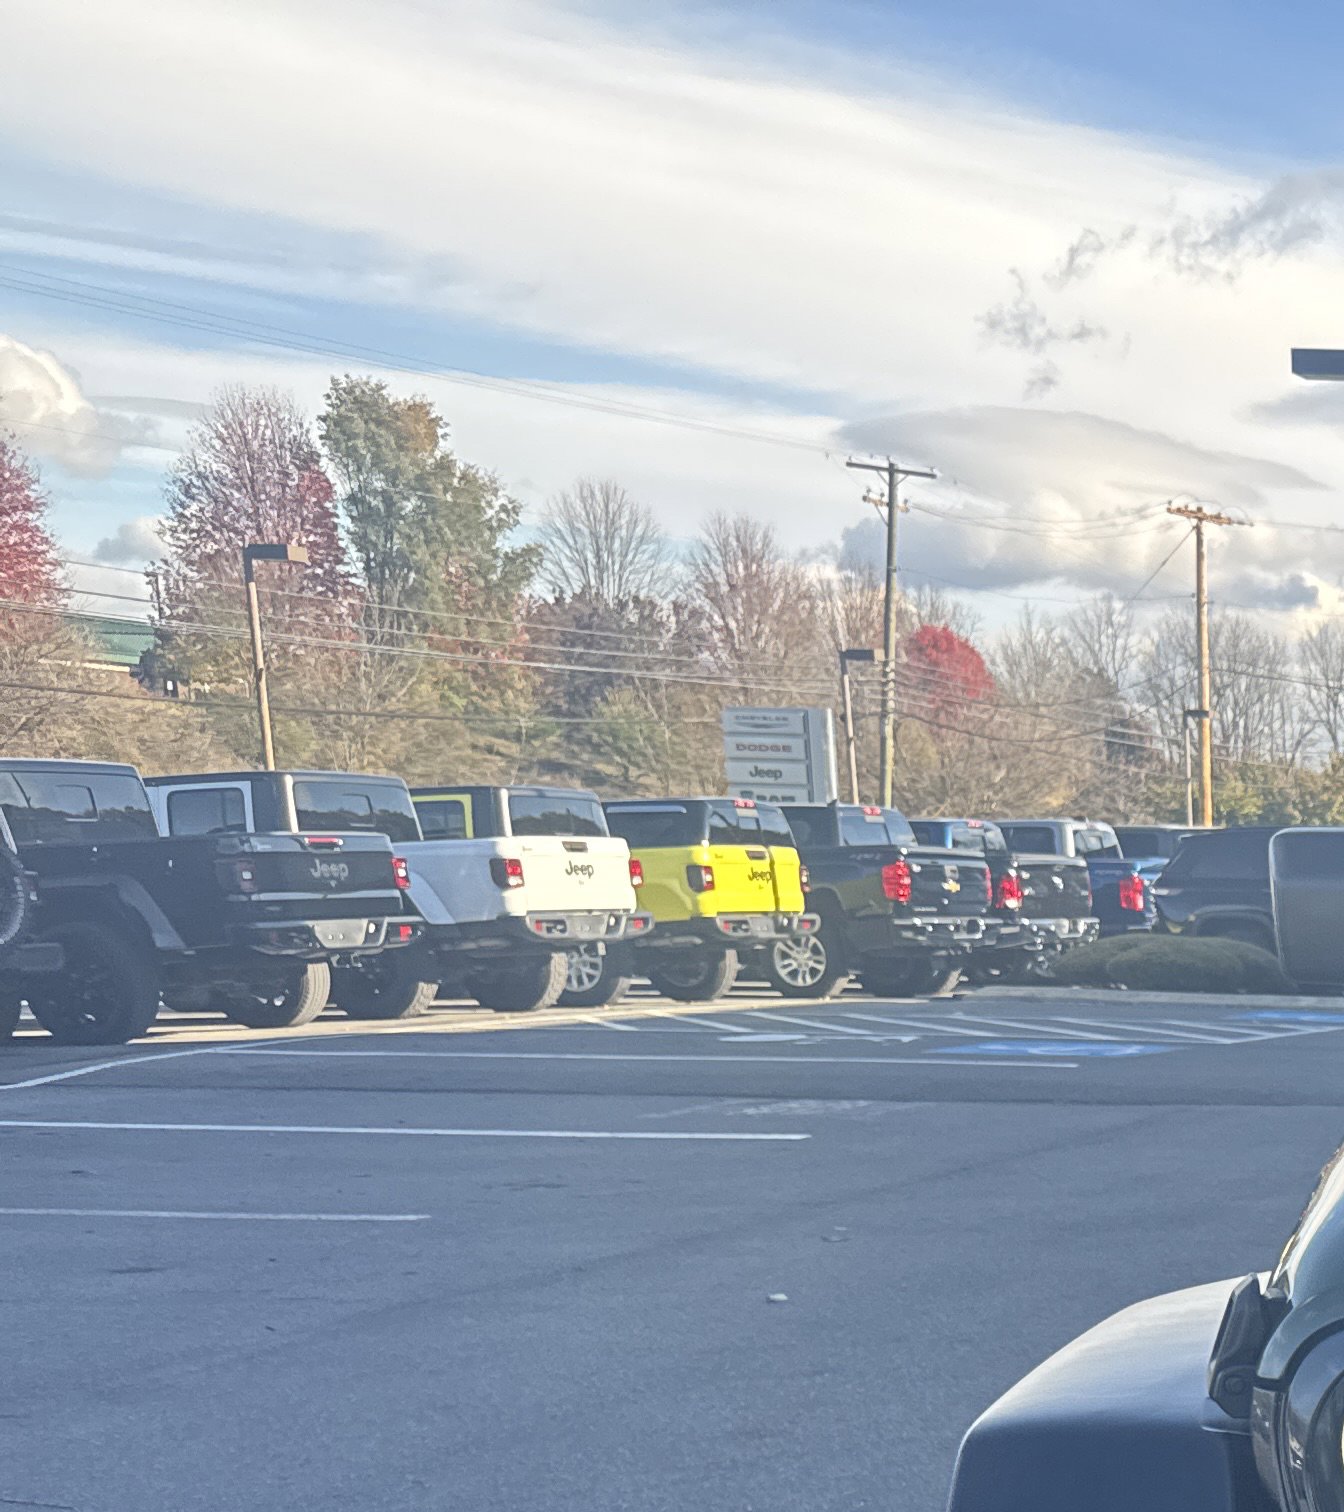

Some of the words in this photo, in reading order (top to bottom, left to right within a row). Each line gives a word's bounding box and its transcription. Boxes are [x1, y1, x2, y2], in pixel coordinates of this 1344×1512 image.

[735, 743, 793, 753] DODGE
[749, 765, 783, 781] Jeep
[310, 858, 349, 881] Jeep
[565, 860, 595, 879] Jeep
[747, 867, 772, 884] Jeep
